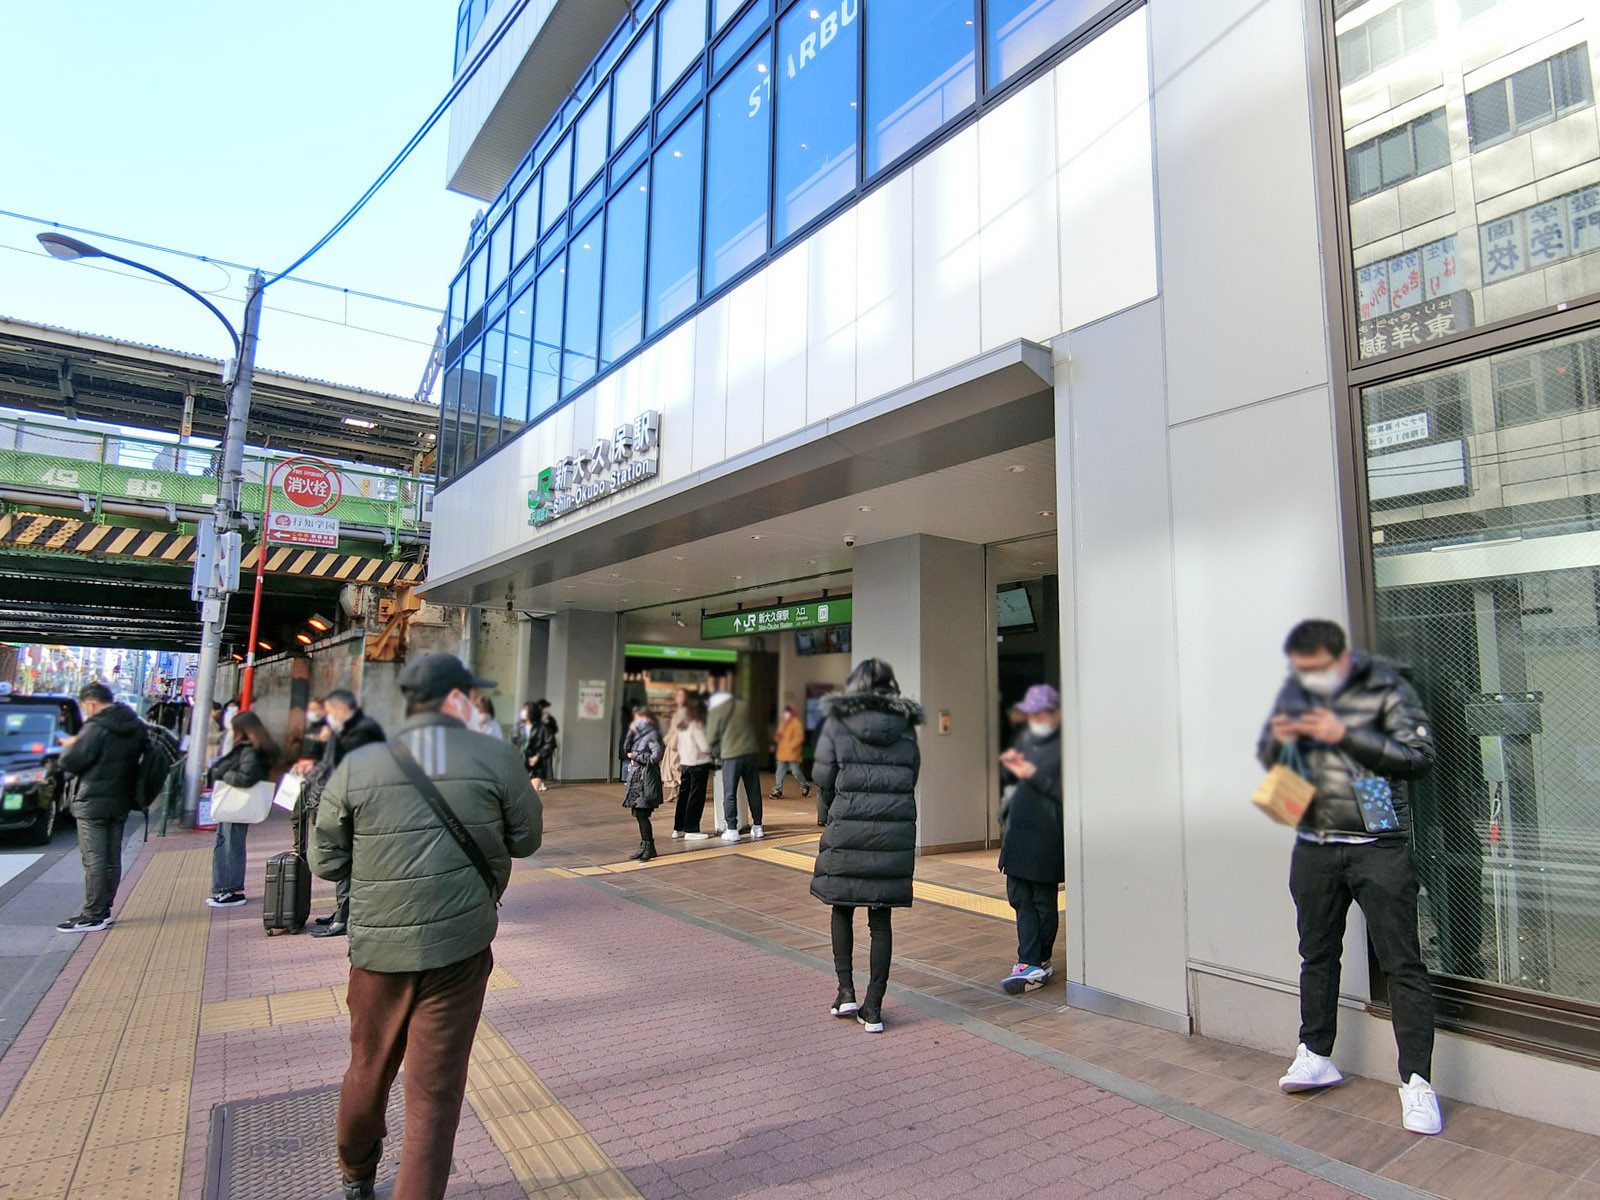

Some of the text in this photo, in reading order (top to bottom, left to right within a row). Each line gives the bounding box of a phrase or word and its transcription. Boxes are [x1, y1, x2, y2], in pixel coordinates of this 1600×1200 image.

[555, 410, 657, 491] 新大久保駅
[287, 476, 328, 498] 消火栓
[528, 467, 555, 510] JR
[553, 458, 655, 514] Shin-Okubo Station
[743, 614, 757, 628] JR
[758, 609, 790, 624] 新大久保駅
[796, 607, 806, 616] 入口
